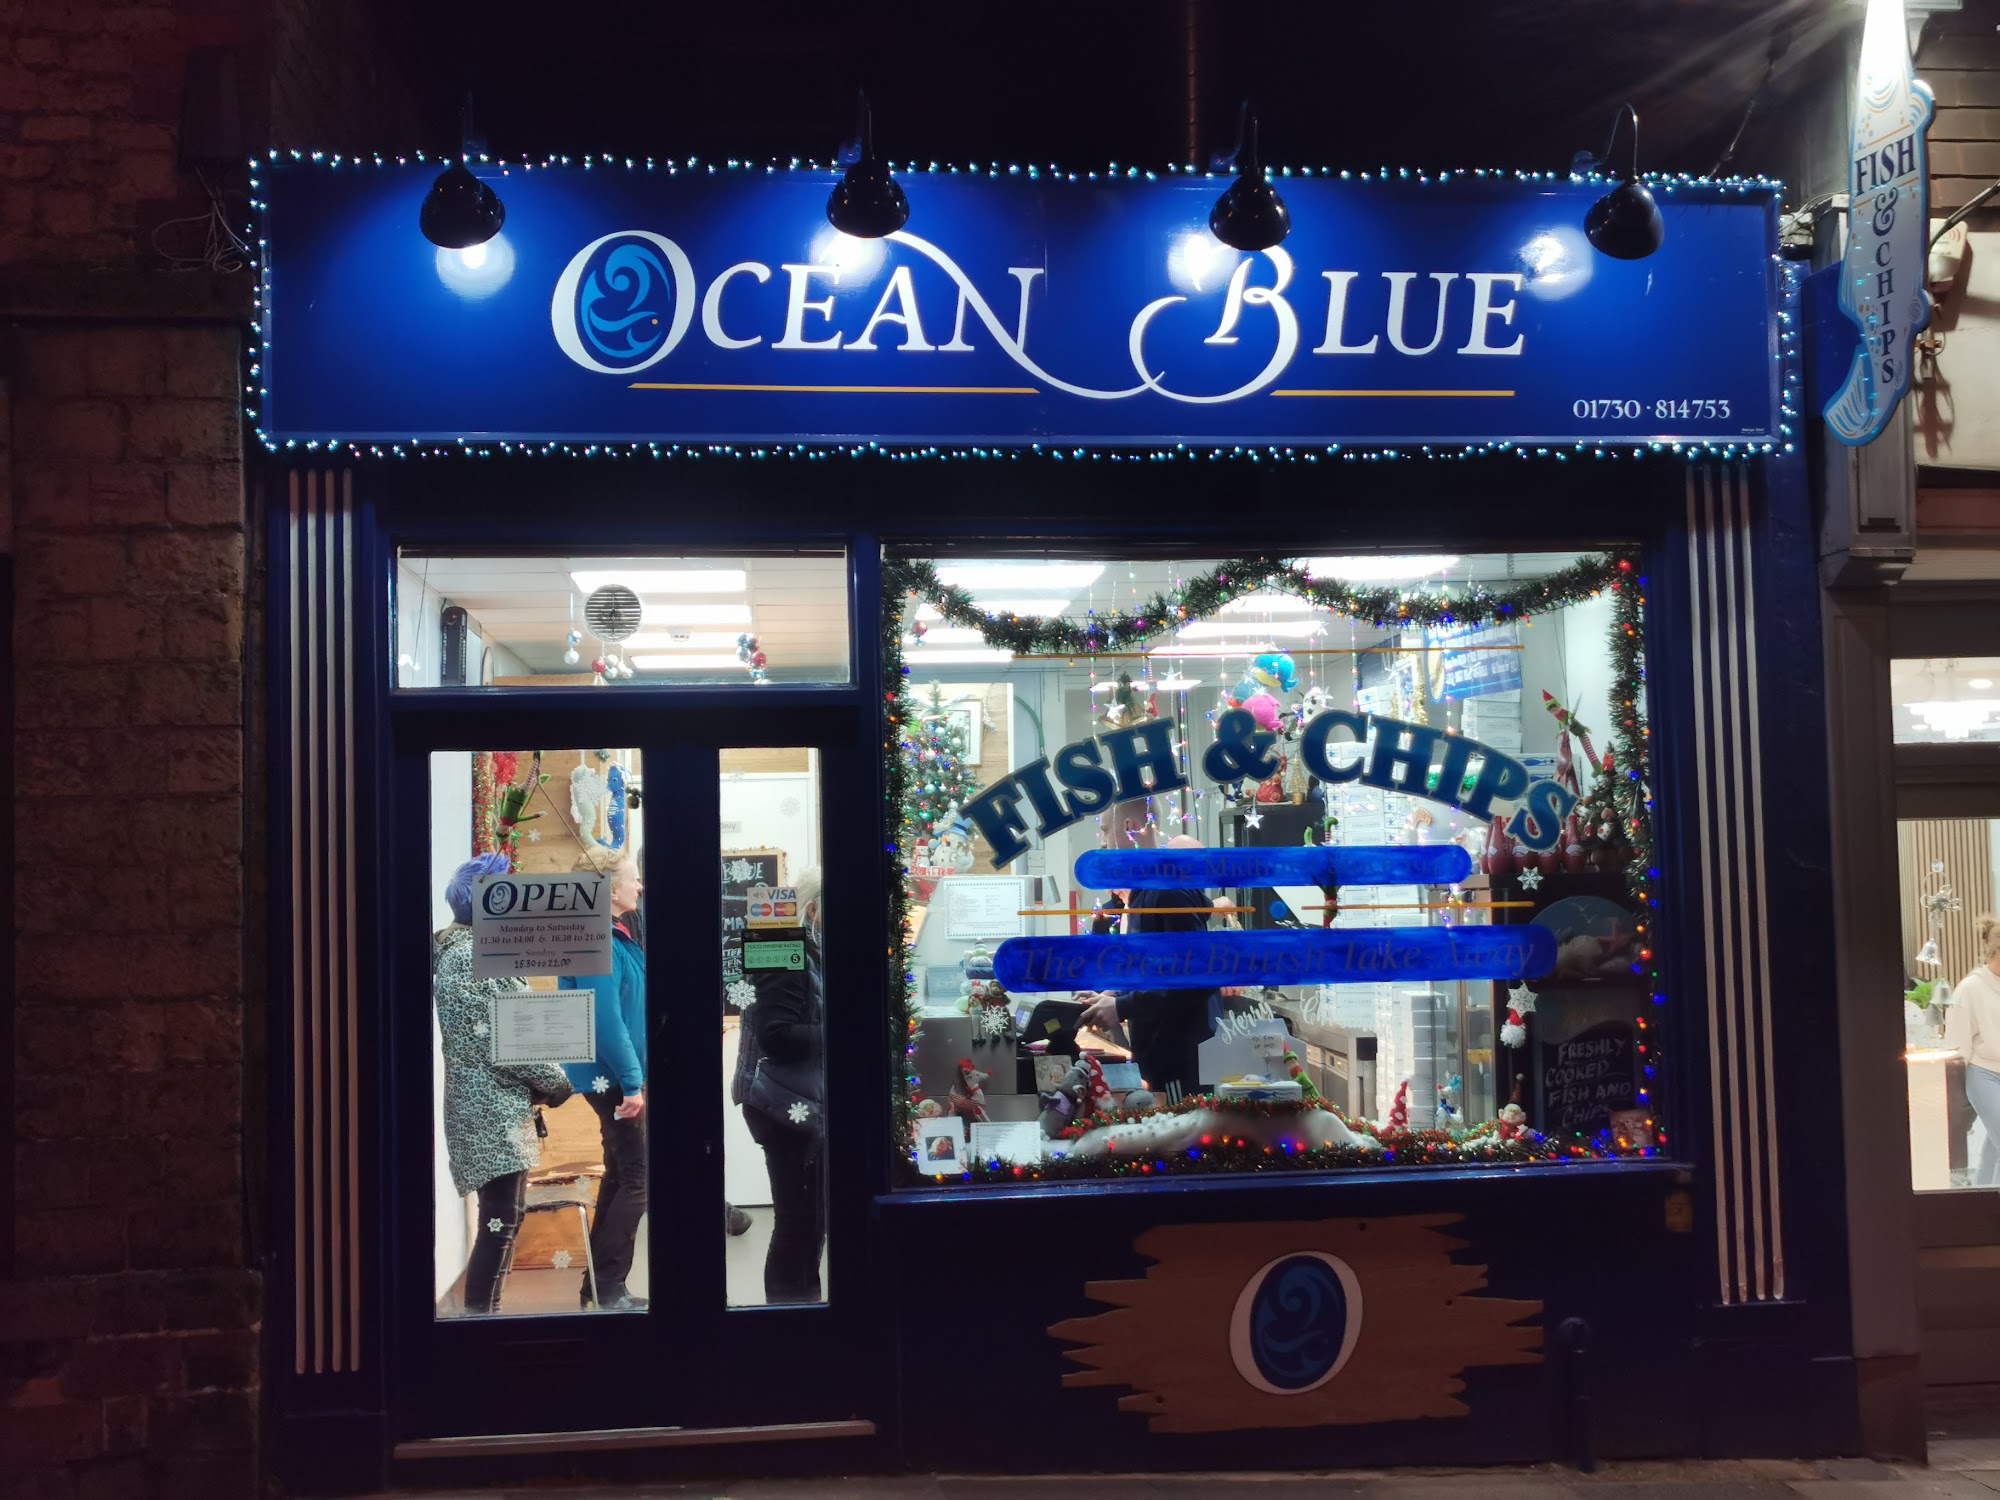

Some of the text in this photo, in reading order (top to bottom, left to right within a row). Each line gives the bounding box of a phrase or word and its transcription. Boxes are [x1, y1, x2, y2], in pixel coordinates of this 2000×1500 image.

[1855, 134, 1916, 198] FISH
[1872, 187, 1899, 236] &
[551, 230, 1524, 404] OCEAN BLUE
[1874, 242, 1897, 385] CHIPS
[1573, 400, 1731, 419] 01730 814753
[957, 708, 1580, 871] FISH & CHIPS
[482, 881, 601, 915] OPEN
[768, 889, 796, 900] VISA
[500, 925, 534, 933] Monday
[547, 923, 585, 932] Saturday
[1019, 945, 1086, 981] The
[1096, 944, 1193, 977] Great
[1206, 940, 1326, 975] British
[1558, 1038, 1625, 1066] FRESHLY
[1545, 1059, 1610, 1087] COOKED
[1596, 1082, 1632, 1099] AND
